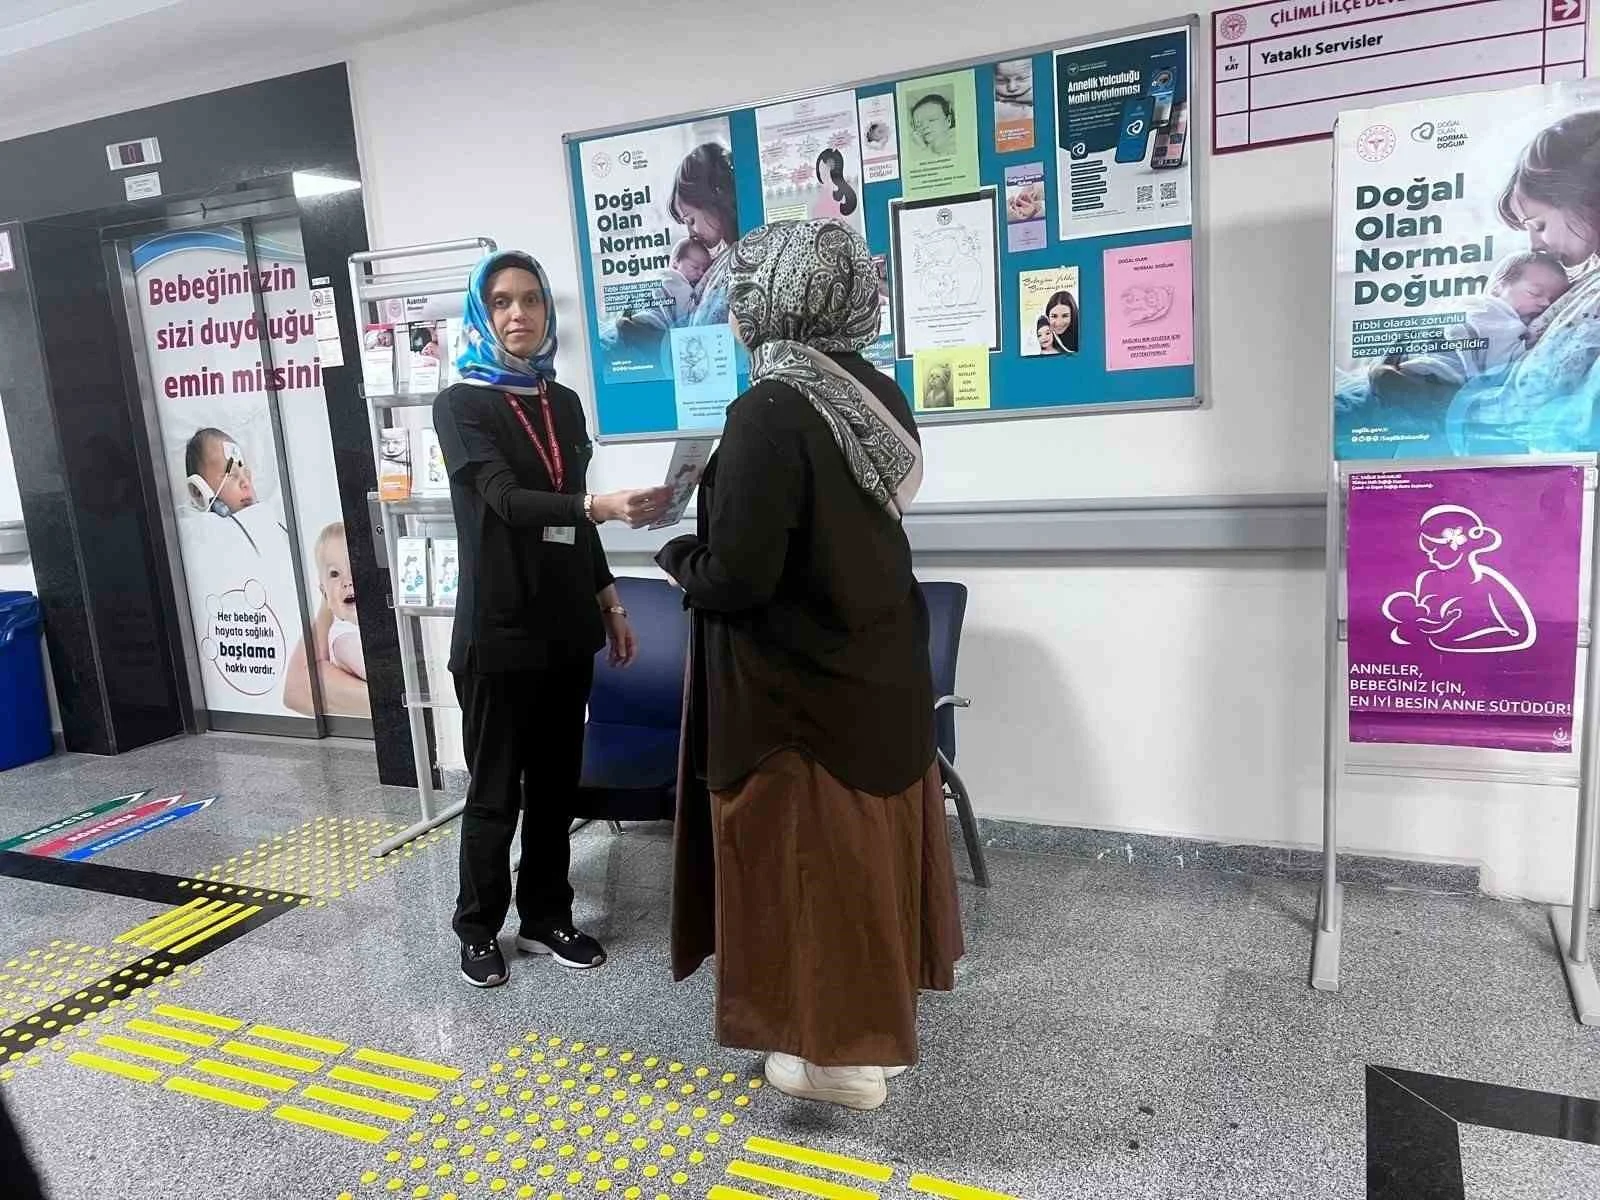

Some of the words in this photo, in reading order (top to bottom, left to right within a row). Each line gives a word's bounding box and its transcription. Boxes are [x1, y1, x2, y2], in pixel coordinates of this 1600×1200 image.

[1270, 2, 1326, 28] ÇİLİMLİ
[1329, 0, 1361, 14] İLÇE
[1260, 46, 1312, 65] Yataklı
[1315, 34, 1384, 56] Servisler
[1224, 63, 1240, 71] KAT
[1067, 77, 1099, 93] Annelik
[1099, 70, 1140, 87] Yolculuğu
[1068, 90, 1090, 105] Mobil
[1090, 84, 1141, 102] Uygulaması
[1436, 141, 1465, 149] DOĞUM
[1437, 134, 1468, 142] NORMAL
[594, 185, 652, 211] Doğal
[1356, 172, 1465, 211] Doğal
[597, 212, 643, 232] Olan
[1355, 213, 1442, 242] Olan
[599, 228, 671, 254] Normal
[601, 253, 671, 276] Doğum
[1354, 235, 1494, 273] Normal
[1354, 273, 1490, 307] Doğum
[1383, 317, 1418, 329] olarak
[1420, 312, 1466, 326] zorunlu
[156, 318, 194, 350] sizi
[1353, 330, 1402, 345] olmadığı
[1403, 328, 1443, 340] sürece
[1353, 344, 1403, 358] sezaryen
[1405, 341, 1439, 355] doğal
[1440, 338, 1489, 353] değildir.
[164, 366, 225, 399] emin
[217, 611, 232, 622] Her
[233, 612, 267, 625] bebeğin
[215, 625, 243, 639] hayata
[245, 626, 274, 640] sağlıklı
[219, 641, 276, 661] başlama
[225, 662, 247, 673] hakkı
[248, 663, 276, 676] vardır.
[1350, 663, 1424, 679] ANNELER,
[1350, 679, 1427, 694] BEBEĞİNİZ
[1431, 680, 1466, 697] İÇİN,
[1350, 695, 1369, 708] EN
[1373, 694, 1391, 708] İYİ
[1395, 695, 1439, 710] BESİN
[1442, 699, 1486, 712] ANNE
[1488, 699, 1572, 715] SÜTÜDÜR!
